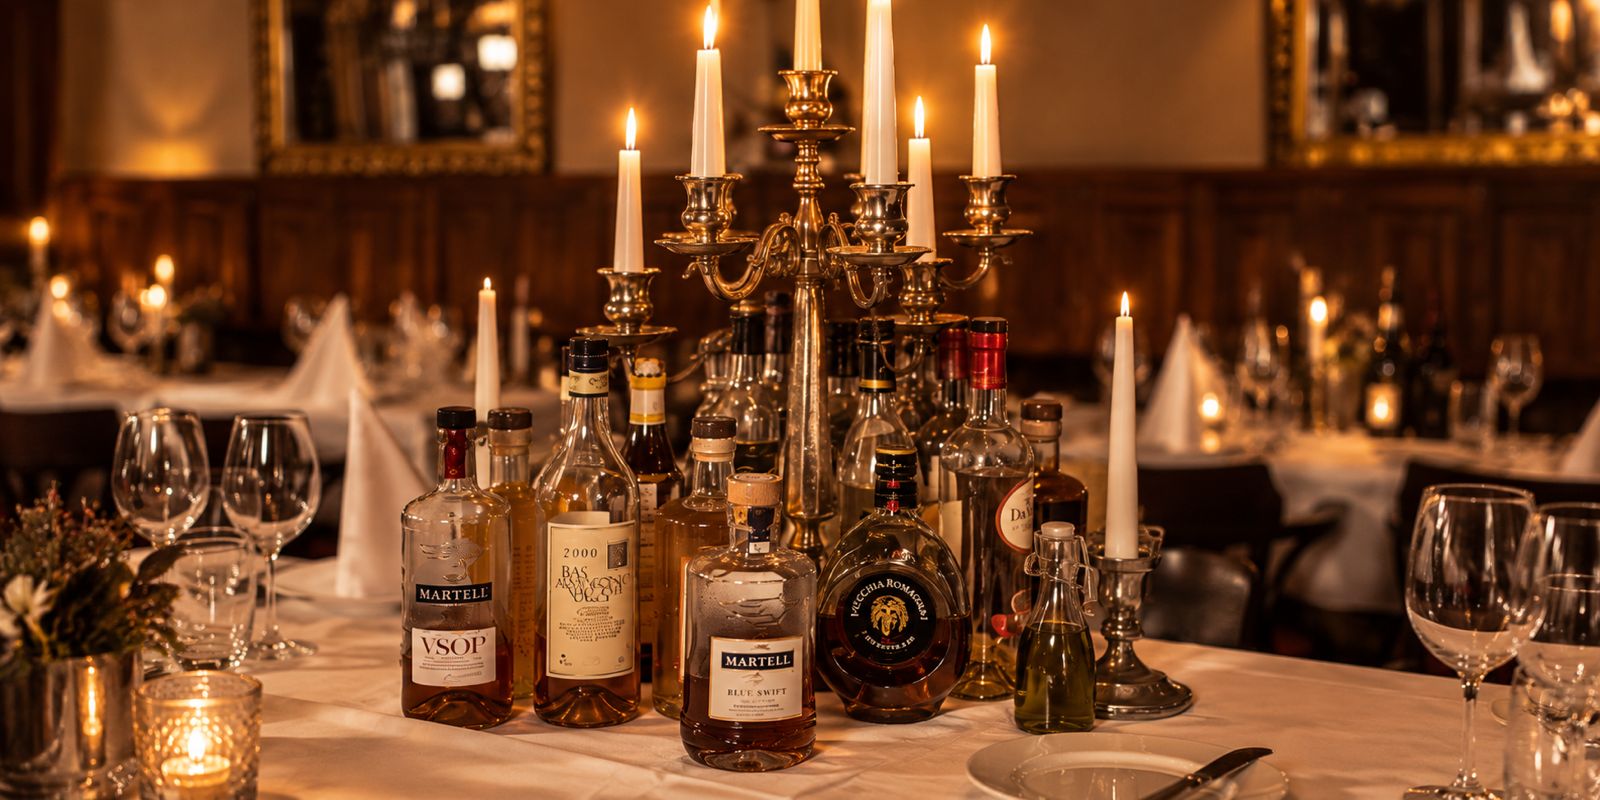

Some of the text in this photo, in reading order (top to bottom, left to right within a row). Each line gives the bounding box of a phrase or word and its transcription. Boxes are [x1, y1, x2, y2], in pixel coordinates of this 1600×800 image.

[563, 547, 598, 558] 2000
[561, 565, 588, 579] BAS
[419, 587, 488, 600] MARTELL
[420, 635, 486, 656] VSOP
[724, 655, 791, 667] MARTELL
[727, 687, 787, 697] BLUE SWIFT
